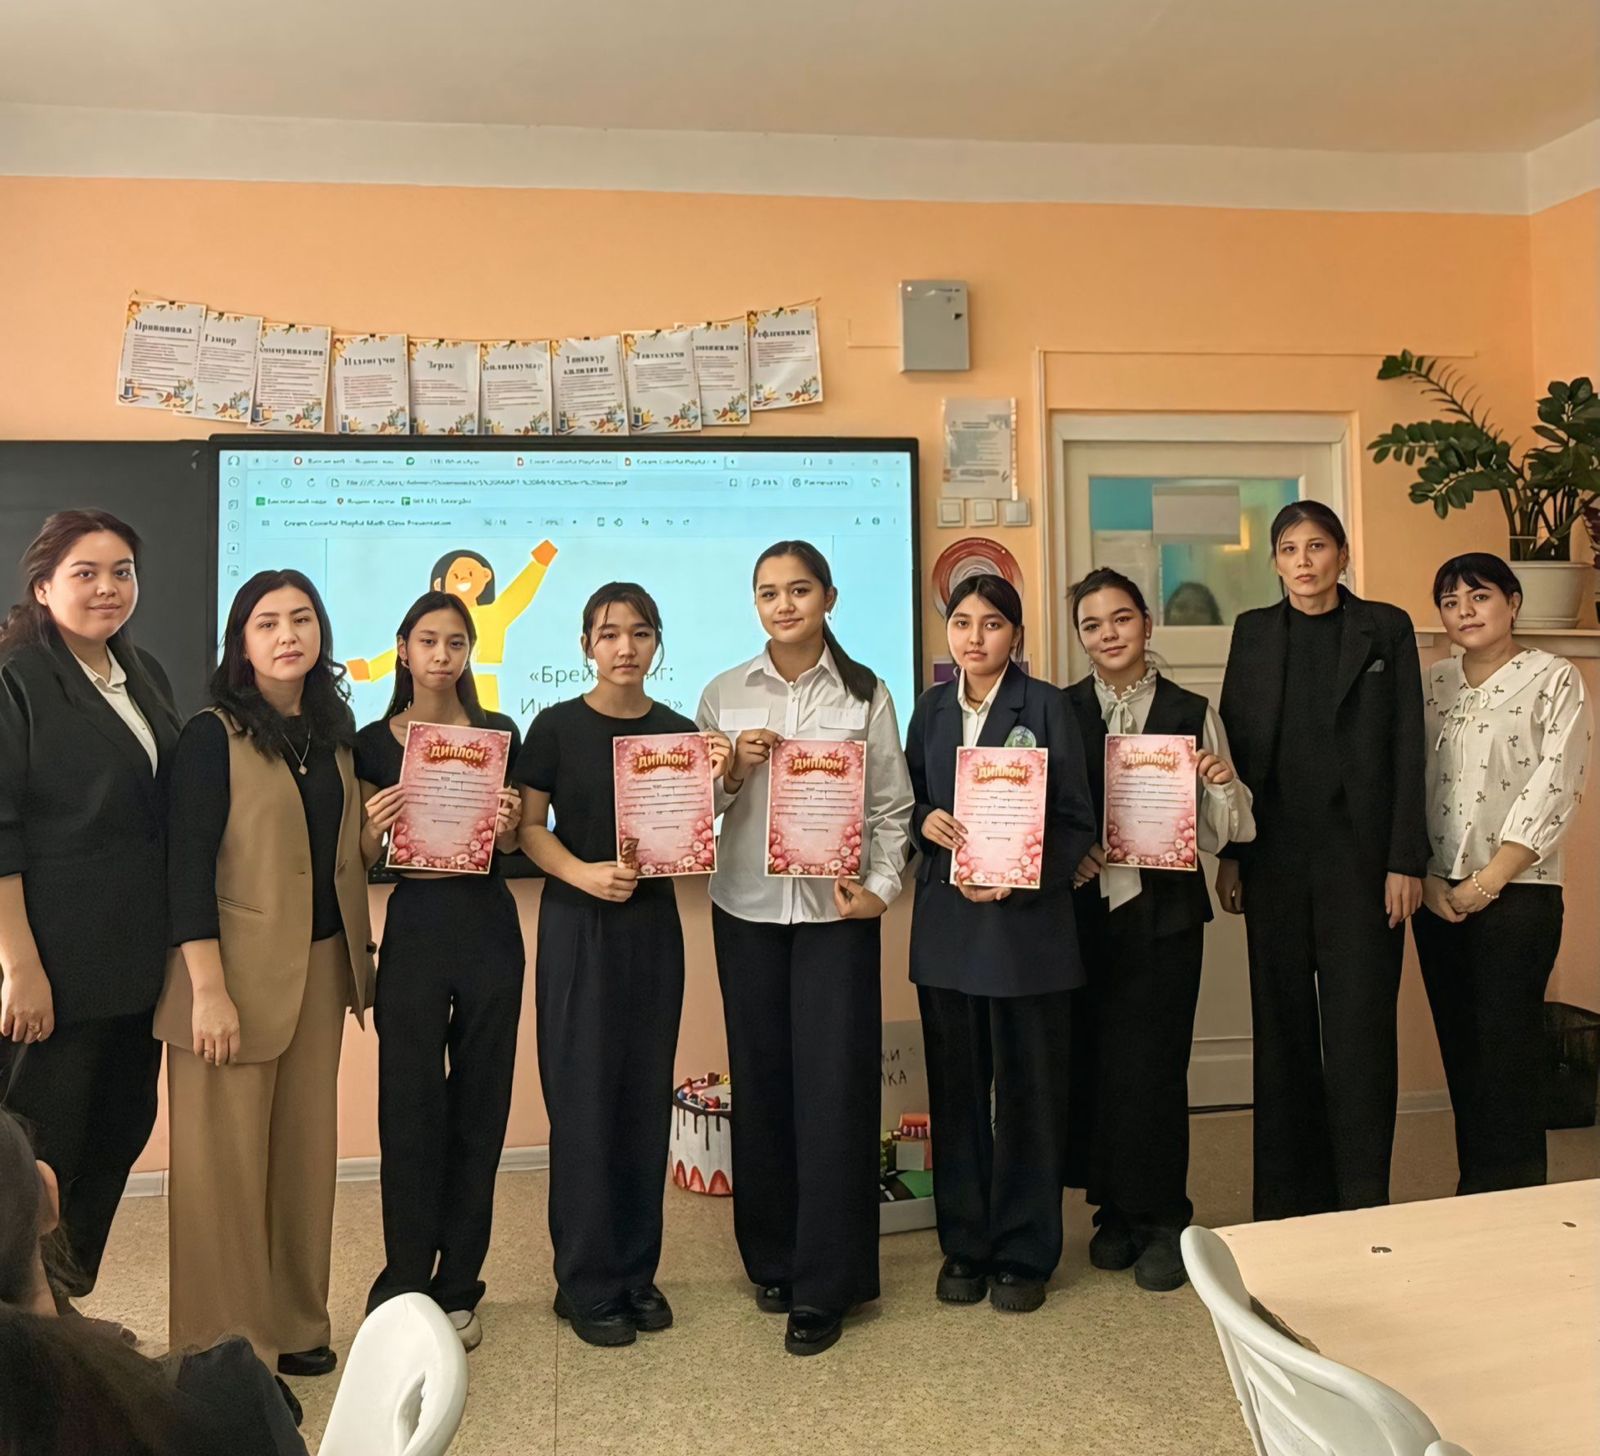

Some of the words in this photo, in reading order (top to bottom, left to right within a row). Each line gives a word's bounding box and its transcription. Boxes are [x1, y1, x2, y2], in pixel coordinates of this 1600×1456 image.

[430, 744, 486, 762] ДИПЛОМ
[1126, 752, 1175, 765] ДИПЛОМ
[638, 752, 690, 769] ДИПЛОМ
[794, 757, 844, 771] ДИПЛОМ
[978, 766, 1028, 779] ДИПЛОМ
